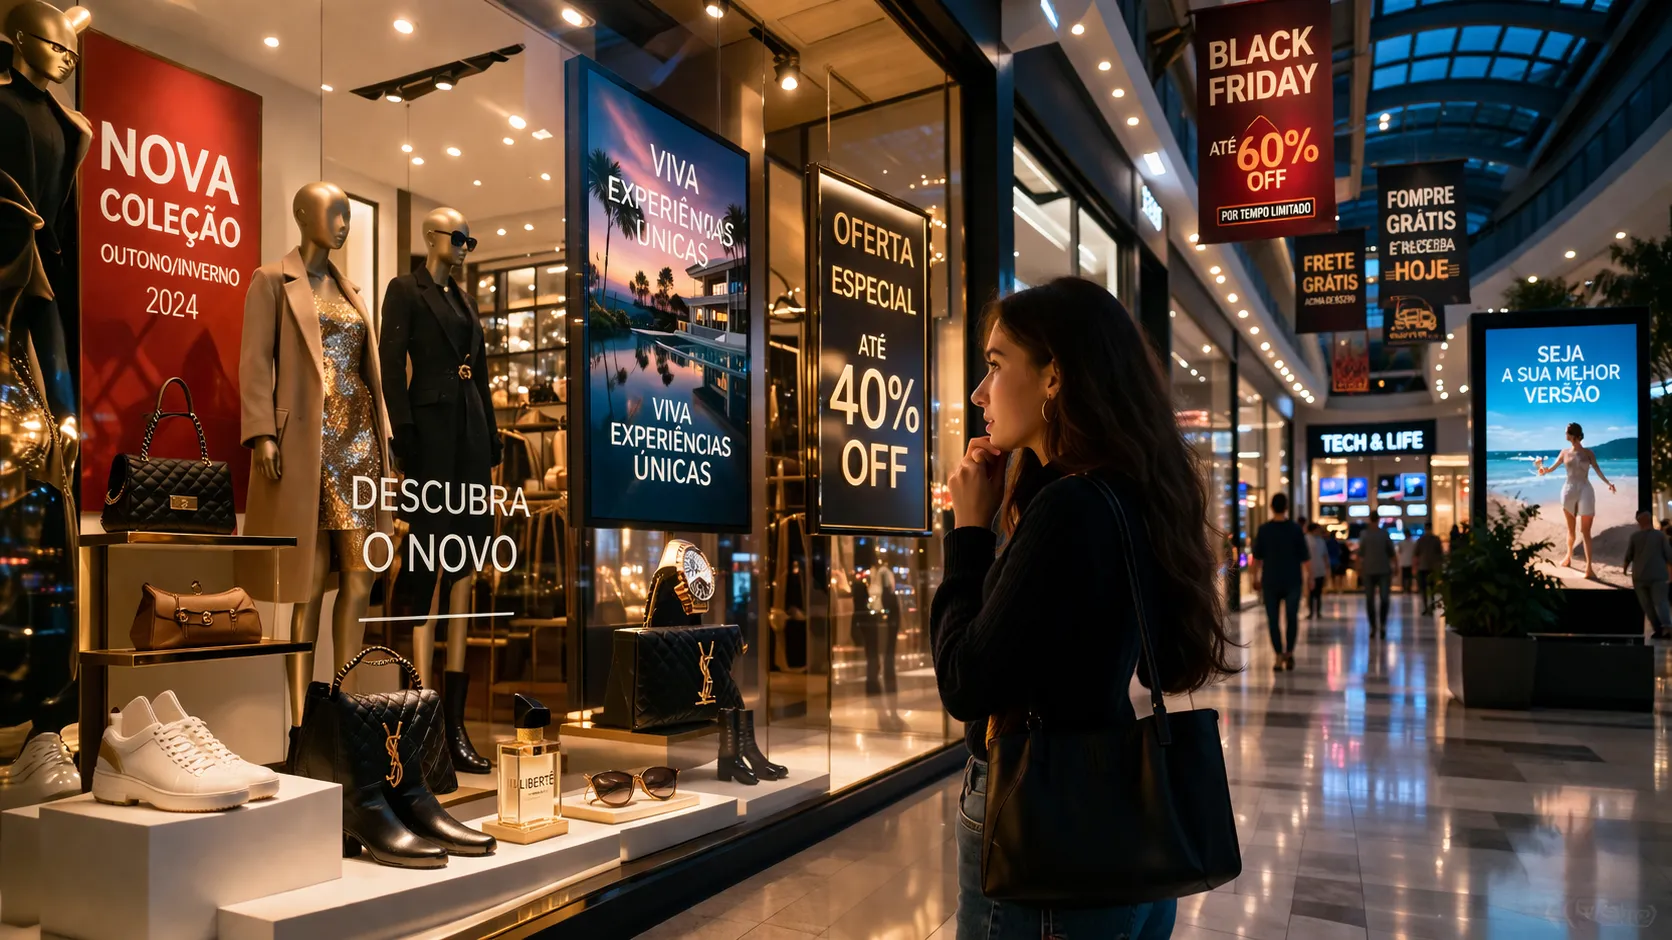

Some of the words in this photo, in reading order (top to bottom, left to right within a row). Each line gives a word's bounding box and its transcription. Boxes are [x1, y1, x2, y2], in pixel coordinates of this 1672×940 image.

[1209, 25, 1314, 70] BLACK
[1209, 62, 1319, 107] FRIDAY
[101, 120, 240, 205] NOVA
[1209, 136, 1237, 157] ATÉ
[1237, 127, 1319, 171] 60%
[650, 143, 699, 195] VIVA
[1247, 168, 1287, 192] OFF
[1221, 208, 1239, 222] POR
[1240, 205, 1269, 221] TEMPO
[1271, 202, 1311, 217] LIMITADO
[1387, 185, 1455, 209] FOMPRE
[100, 188, 241, 248] COLEÇÃO
[1386, 209, 1456, 234] GRÁTIS
[833, 211, 915, 268] OFERTA
[100, 243, 240, 287] OUTONO/INVERNO
[1303, 252, 1355, 272] FRETE
[1395, 259, 1449, 281] HOJE
[831, 265, 917, 315] ESPECIAL
[1303, 273, 1359, 293] GRÁTIS
[146, 286, 199, 319] 2024
[858, 333, 887, 360] ATÉ
[1537, 344, 1584, 363] SEJA
[1501, 368, 1514, 382] A
[1517, 366, 1552, 382] SUA
[652, 397, 692, 425] VIVA
[829, 363, 920, 434] 40%
[610, 422, 731, 458] EXPERIÊNCIAS
[1320, 433, 1367, 453] TECH
[1370, 433, 1384, 451] &
[1386, 430, 1424, 450] LIFE
[634, 449, 711, 486] ÚNICAS
[841, 439, 908, 489] OFF
[352, 475, 531, 517] DESCUBRA
[363, 531, 394, 573] O
[408, 533, 517, 573] NOVO
